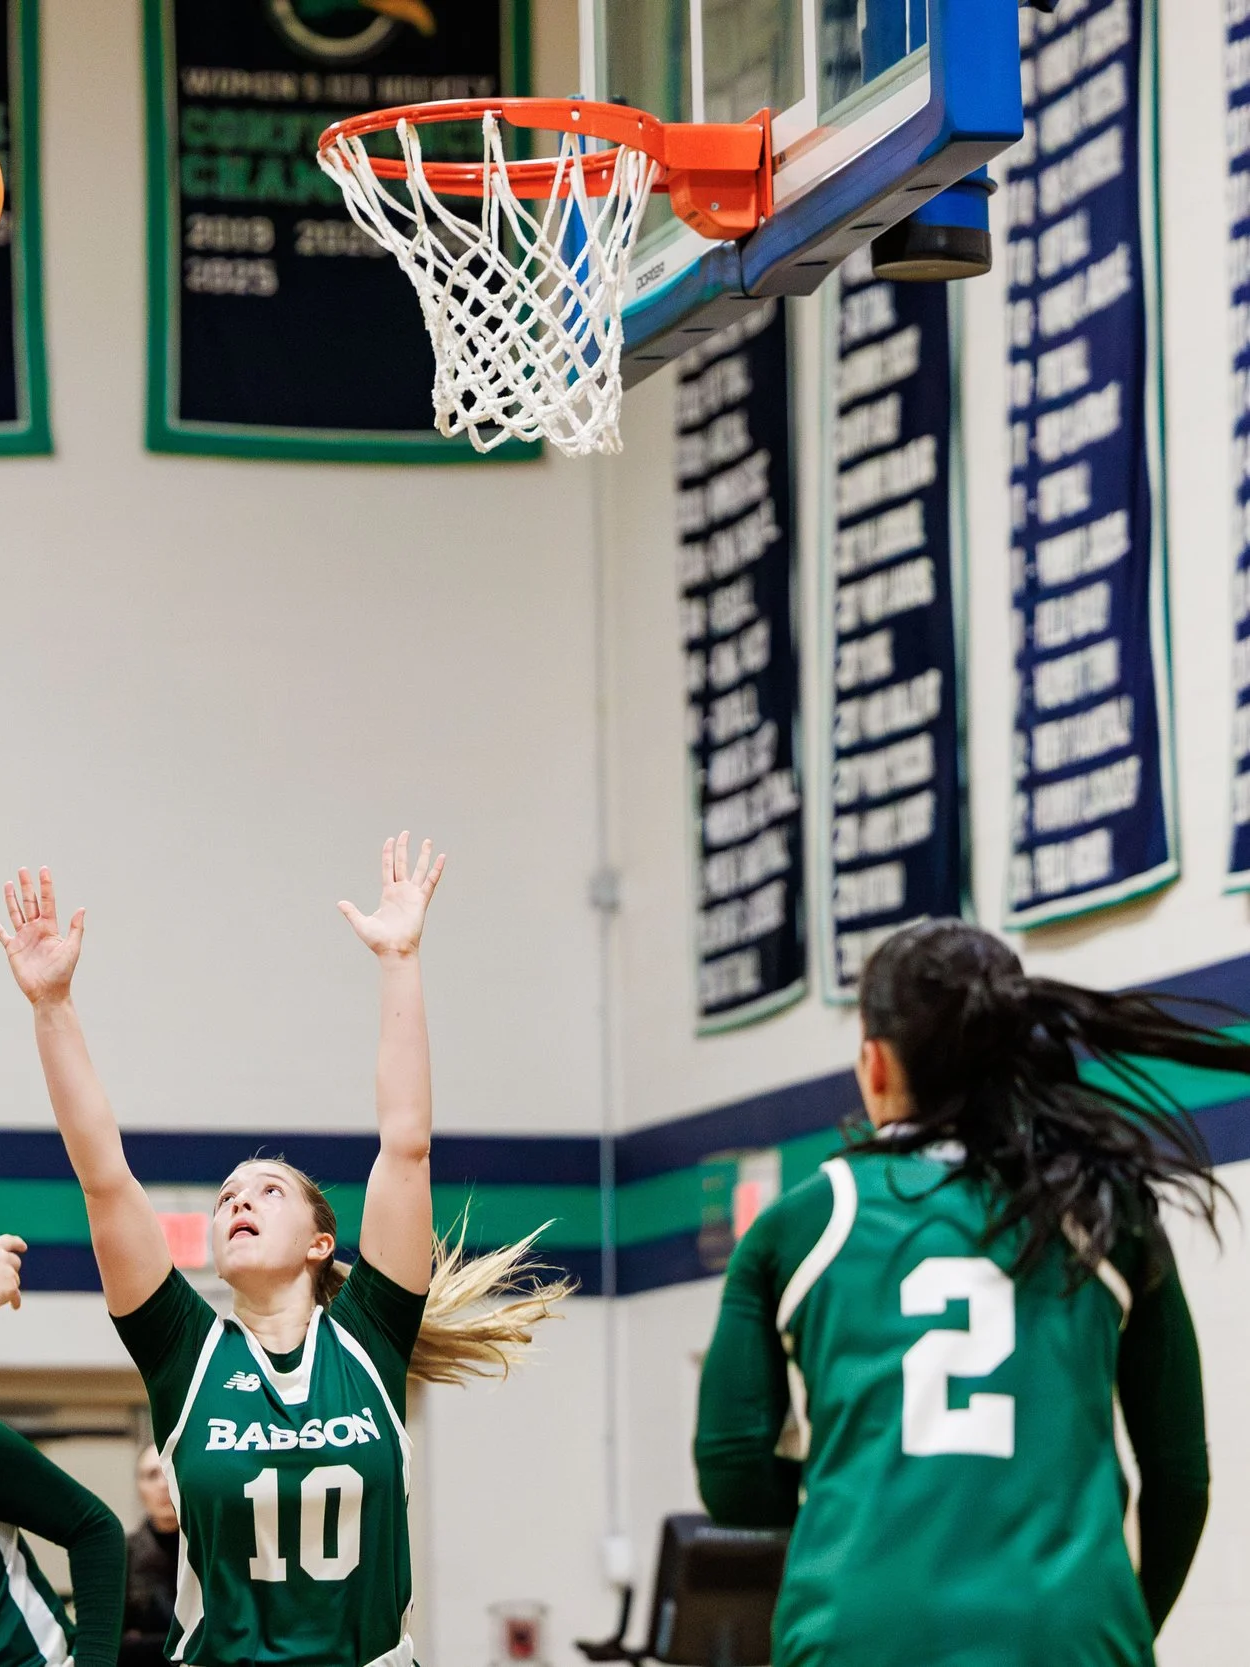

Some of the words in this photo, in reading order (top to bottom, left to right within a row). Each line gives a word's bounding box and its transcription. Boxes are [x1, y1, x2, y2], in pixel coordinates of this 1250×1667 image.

[900, 1257, 1015, 1459] 2
[205, 1407, 381, 1451] BABSON
[244, 1464, 363, 1582] 10
